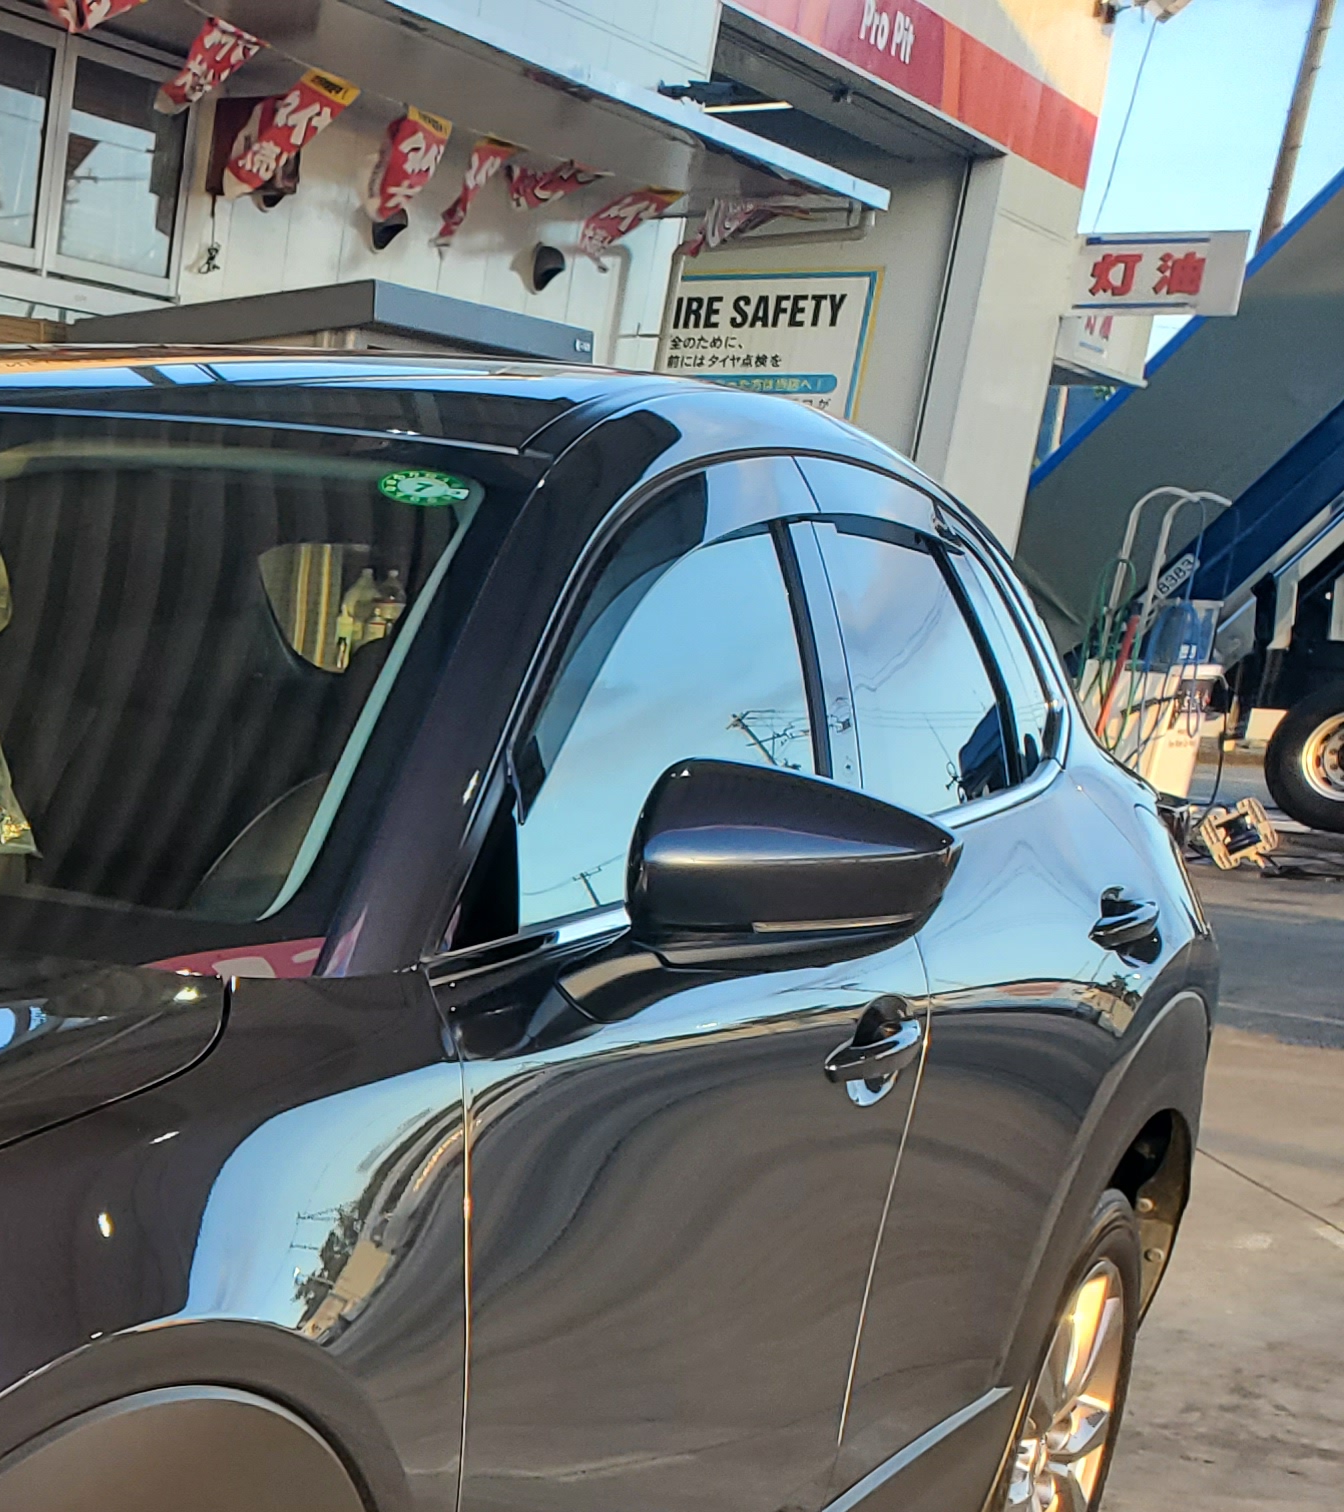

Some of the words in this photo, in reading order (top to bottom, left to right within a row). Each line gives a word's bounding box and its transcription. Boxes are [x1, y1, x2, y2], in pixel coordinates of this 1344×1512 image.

[858, 0, 890, 52] Pro
[890, 10, 916, 64] Pit
[1089, 251, 1207, 297] 灯油
[672, 295, 724, 330] IRE
[729, 293, 848, 329] SAFETY
[667, 353, 783, 369] 前にはタイヤ点検を
